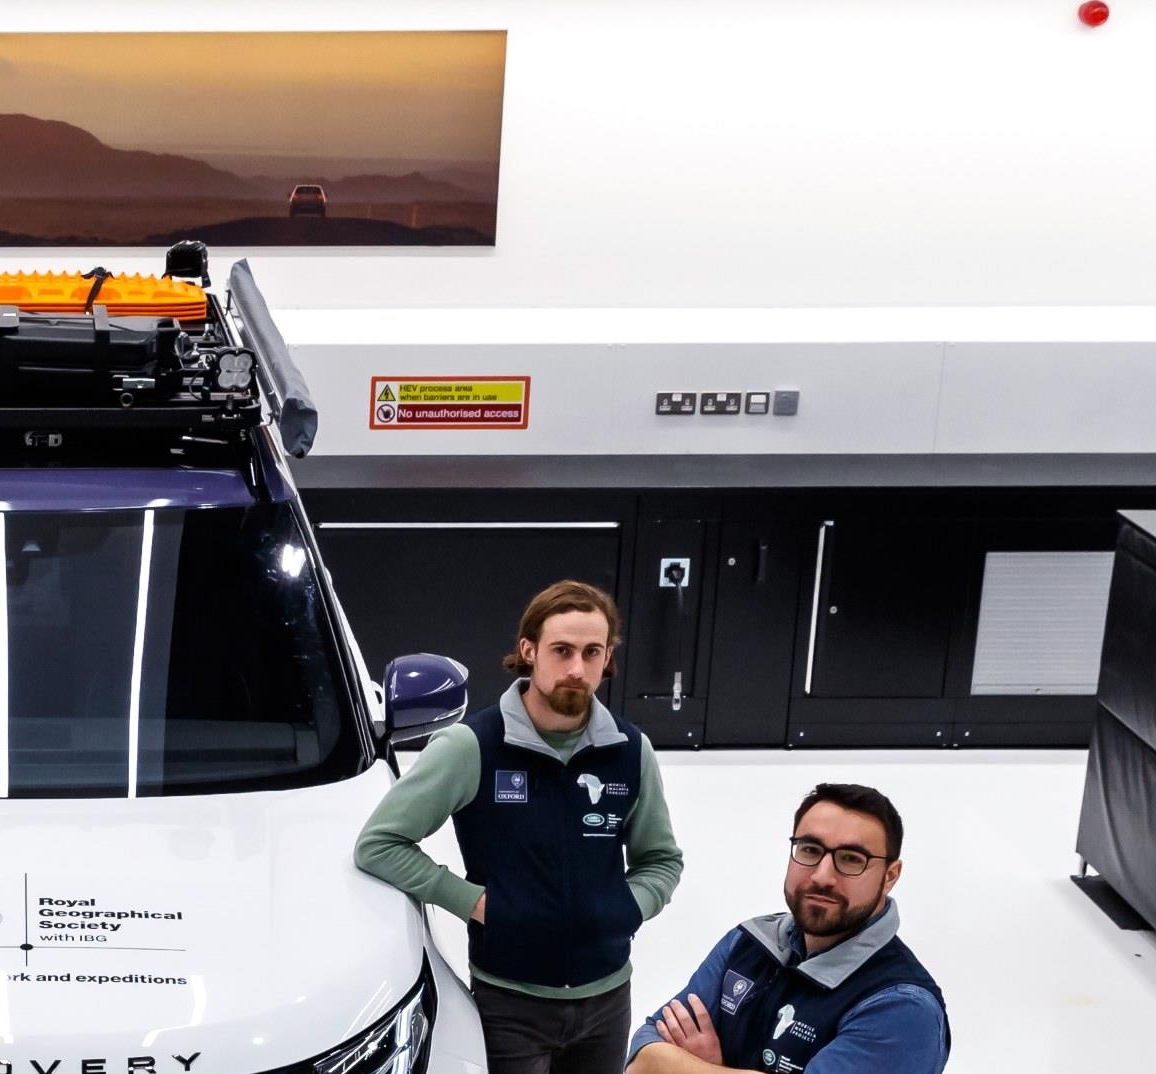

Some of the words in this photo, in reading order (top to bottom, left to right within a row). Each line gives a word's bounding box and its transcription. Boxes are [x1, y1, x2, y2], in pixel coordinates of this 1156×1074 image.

[400, 384, 418, 392] HEV
[420, 385, 452, 393] process
[400, 393, 422, 401] when
[423, 393, 455, 401] barriers
[472, 393, 481, 401] in
[398, 409, 412, 418] No
[416, 408, 481, 418] unauthorised
[484, 410, 519, 418] access
[38, 897, 96, 908] Royal
[38, 908, 183, 920] Geographical
[38, 920, 123, 932] Society
[39, 933, 75, 942] with
[78, 934, 108, 942] IBG
[36, 972, 71, 983] and
[75, 973, 188, 986] expeditions
